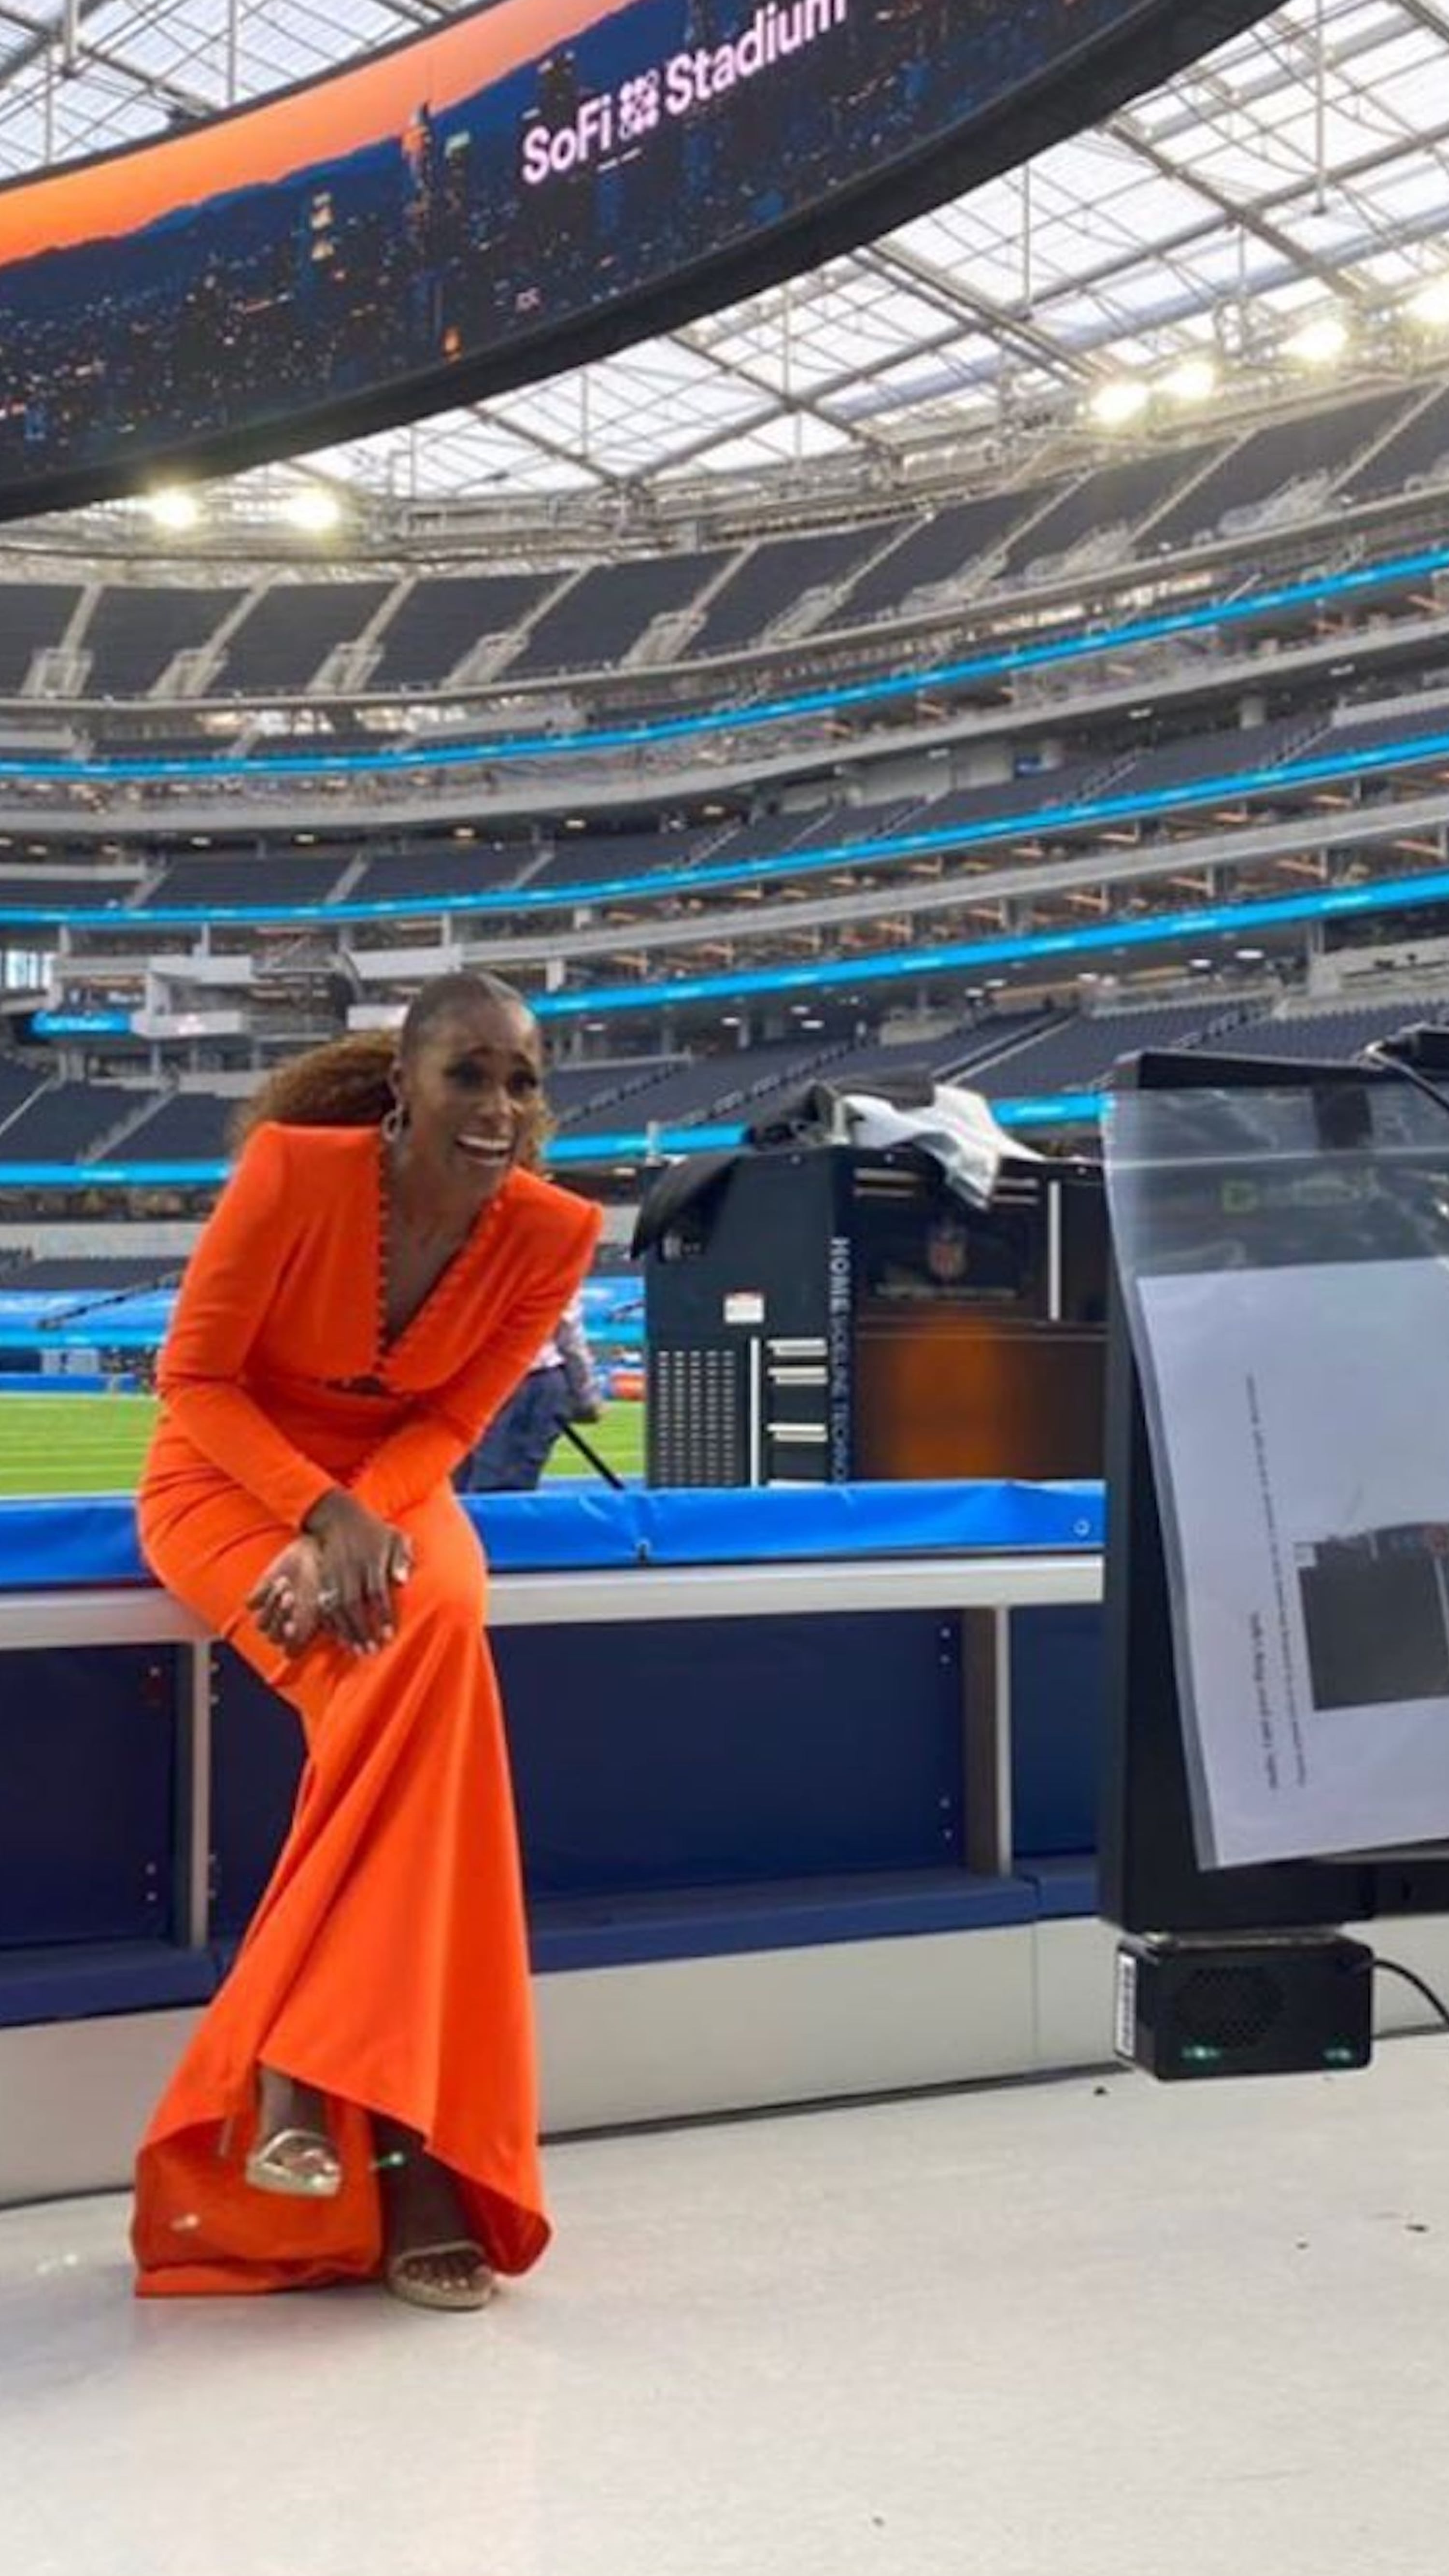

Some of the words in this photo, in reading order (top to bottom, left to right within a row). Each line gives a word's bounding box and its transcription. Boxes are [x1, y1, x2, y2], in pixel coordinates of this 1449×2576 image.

[523, 93, 611, 184] SoFi
[664, 0, 847, 114] Stadium
[829, 1237, 850, 1312] HOME
